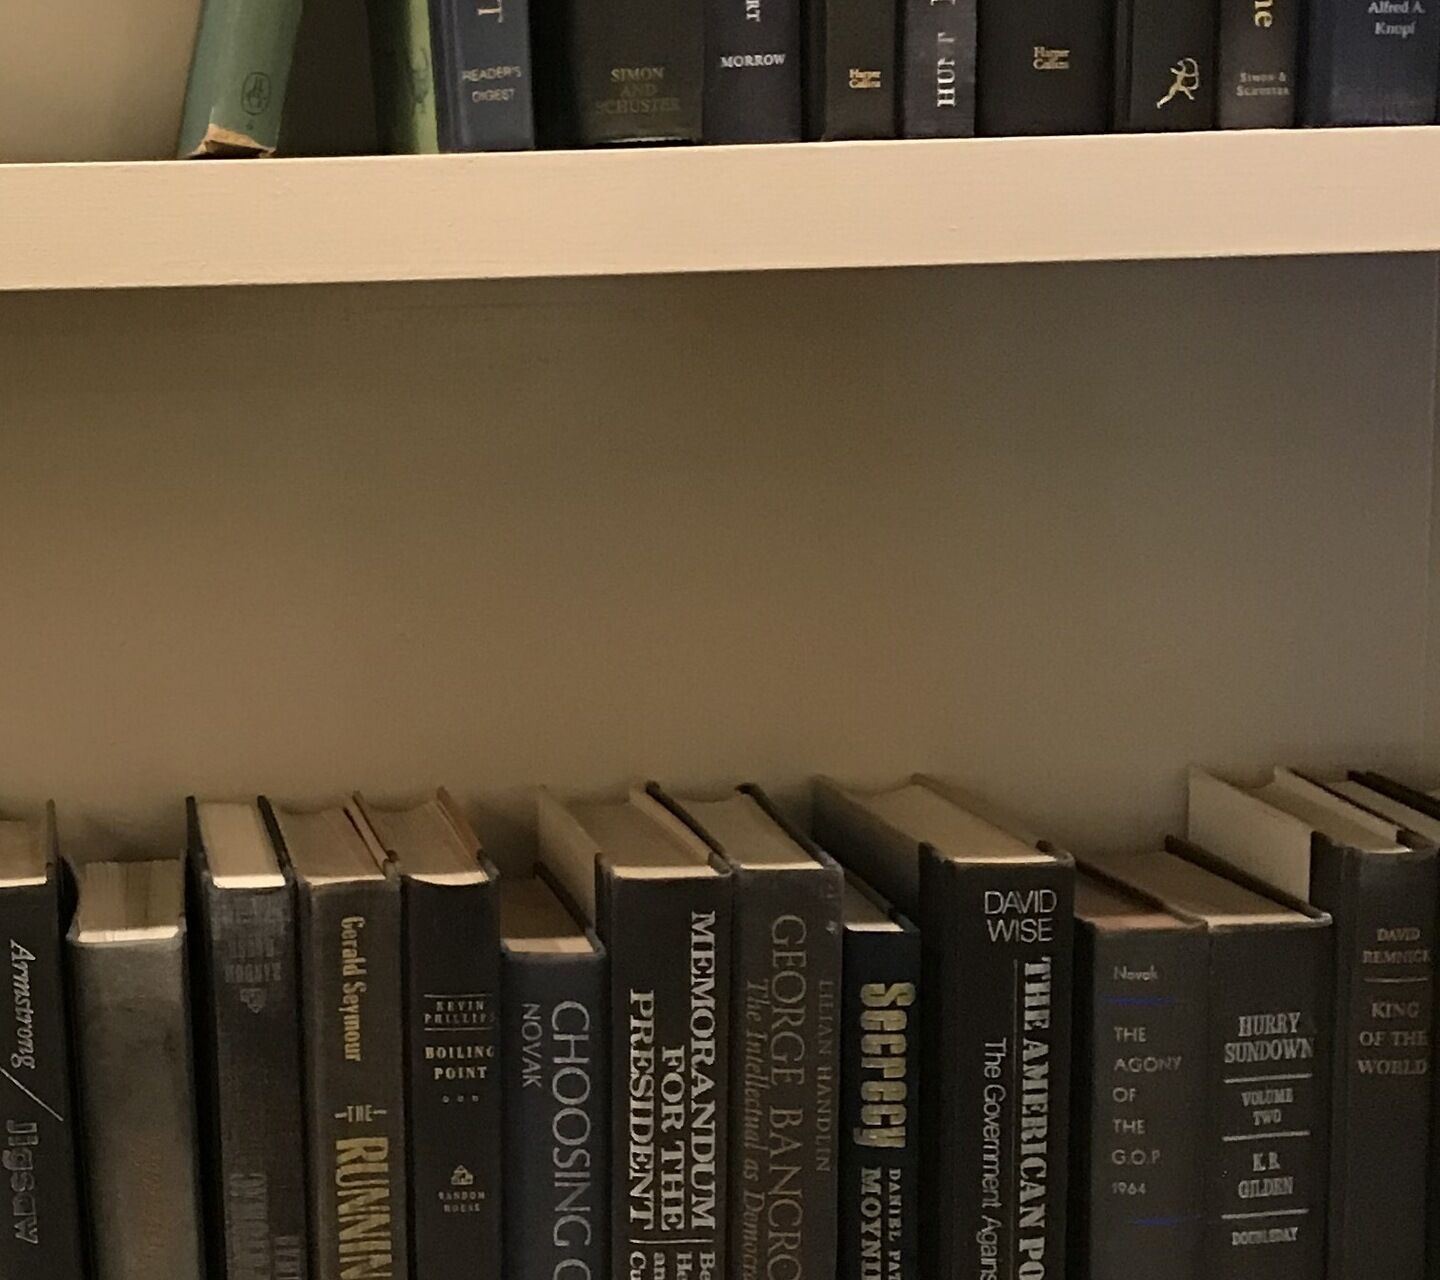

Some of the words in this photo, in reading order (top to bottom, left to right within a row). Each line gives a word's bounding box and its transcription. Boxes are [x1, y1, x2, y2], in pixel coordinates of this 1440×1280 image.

[983, 889, 1058, 916] DAVID
[986, 918, 1055, 944] WISE
[9, 938, 37, 1069] Armstrong
[769, 914, 807, 1087] GEORGE
[817, 978, 835, 1055] LILIAN
[1023, 956, 1052, 1031] THE
[1371, 1001, 1420, 1019] KING
[423, 1045, 496, 1061] BOILING
[520, 1002, 544, 1090] NOVAK
[690, 910, 717, 1231] MEMORANDUM
[851, 982, 917, 1148] Secrecy
[983, 1037, 1008, 1078] The
[1112, 1025, 1147, 1044] THE
[1112, 1055, 1183, 1074] AGONY
[1359, 1030, 1385, 1046] OF
[1389, 1030, 1428, 1046] THE
[433, 1066, 487, 1081] POINT
[629, 988, 656, 1231] PRESIDENT
[660, 1046, 686, 1133] FOR
[1112, 1087, 1137, 1104] OF
[345, 1103, 374, 1122] THE
[551, 1000, 592, 1248] CHOOSING
[813, 1066, 835, 1172] HANDLIN
[981, 1084, 1007, 1208] Government
[1018, 1037, 1050, 1229] AMERICAN
[1112, 1119, 1145, 1136] THE
[1, 1120, 40, 1244] Jigsaw
[660, 1140, 686, 1232] THE
[887, 1168, 902, 1242] DANIEL
